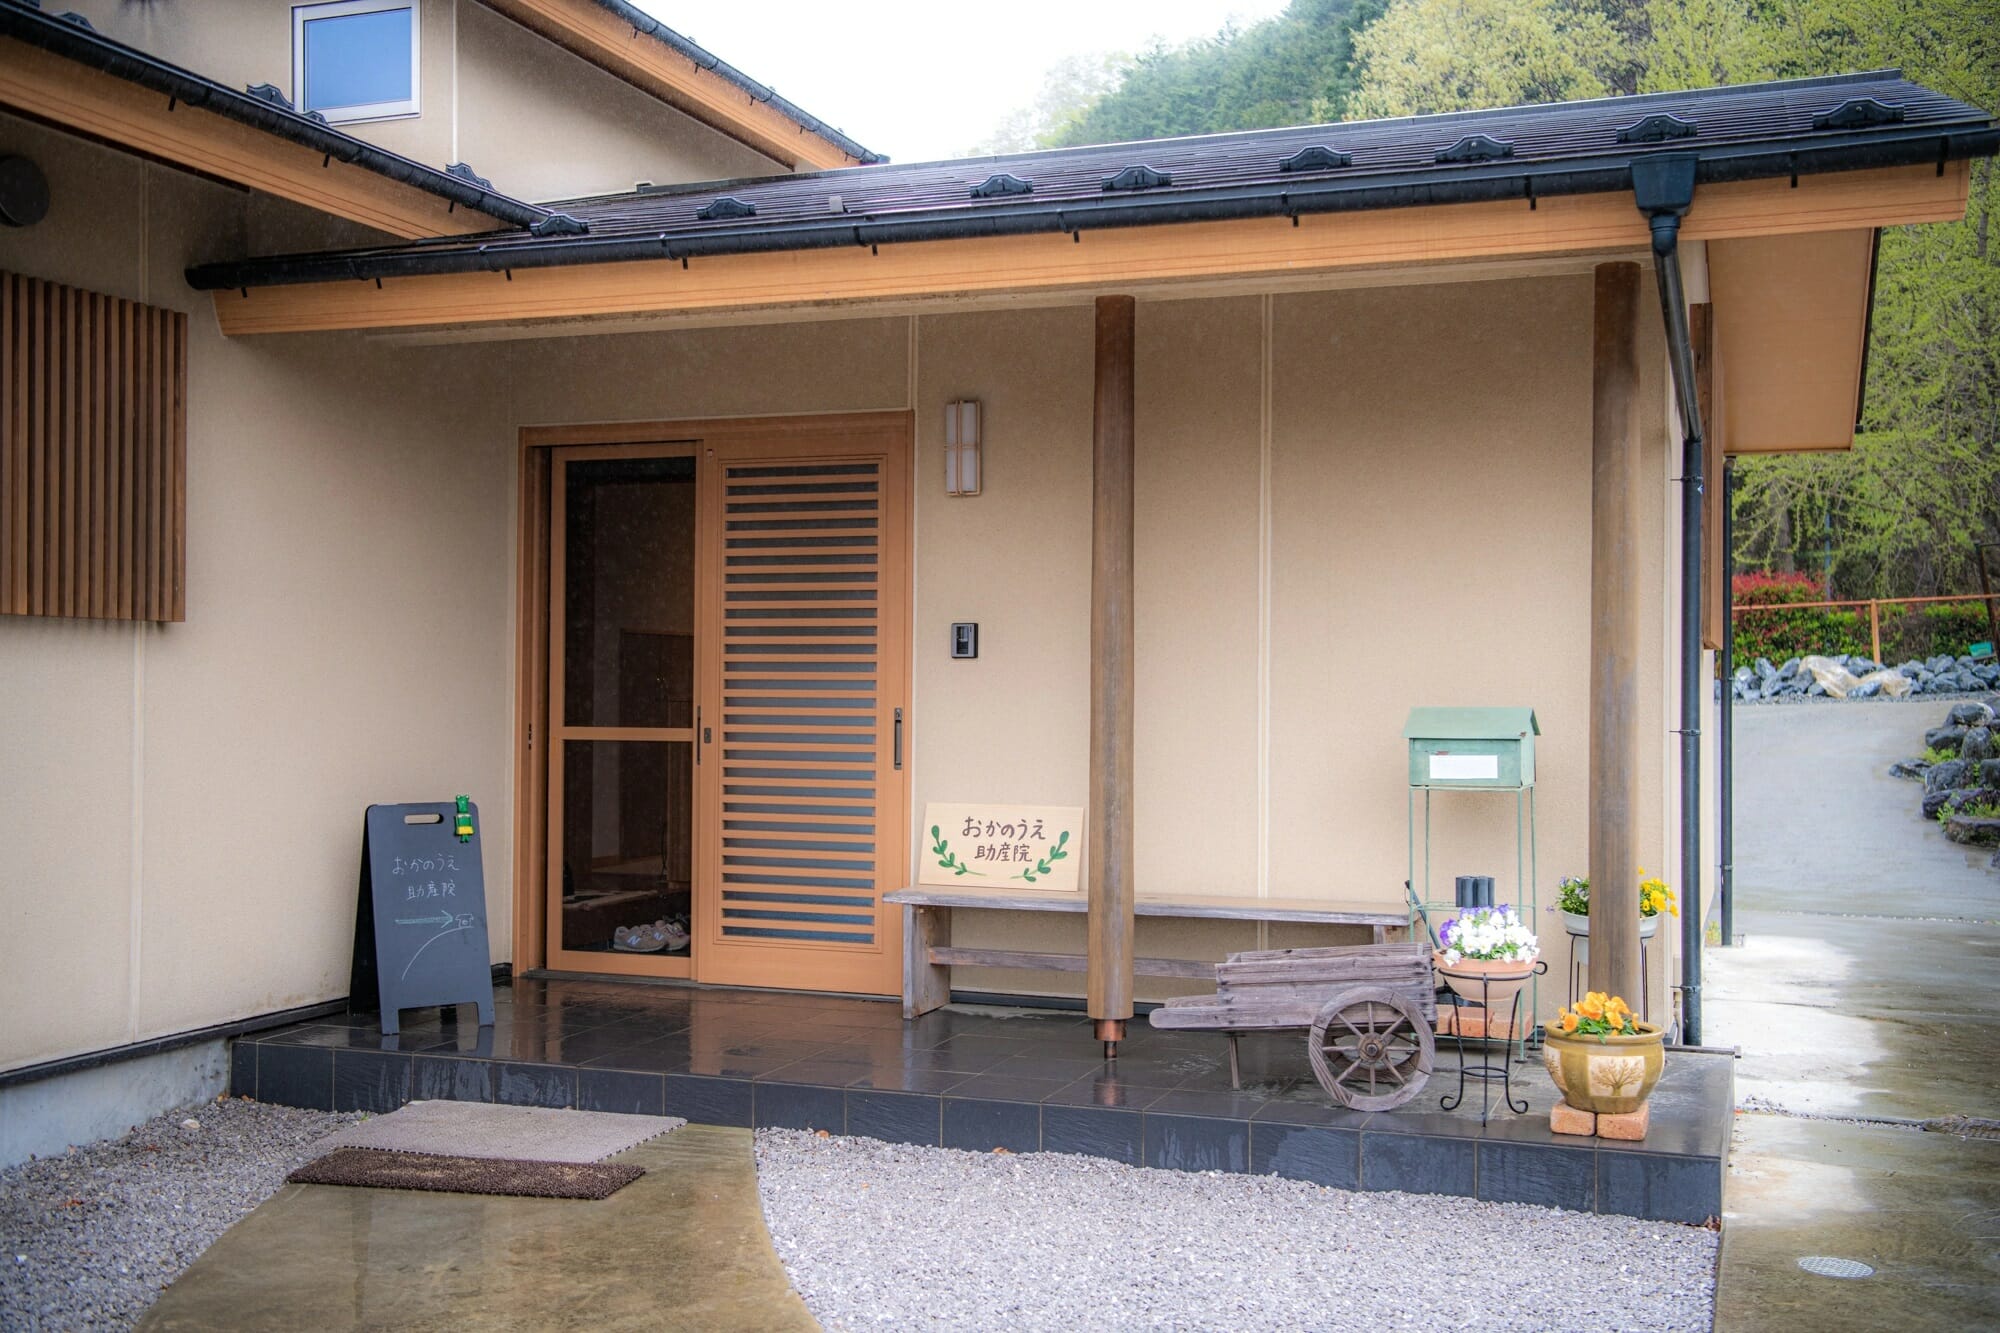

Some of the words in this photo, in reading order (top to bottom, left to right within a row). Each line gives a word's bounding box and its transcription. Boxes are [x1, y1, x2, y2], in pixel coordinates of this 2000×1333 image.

[962, 816, 1046, 841] おかのうえ
[974, 842, 1033, 863] 助産院
[391, 853, 461, 876] おかのうえ
[406, 879, 457, 901] 助産院
[627, 935, 641, 945] N
